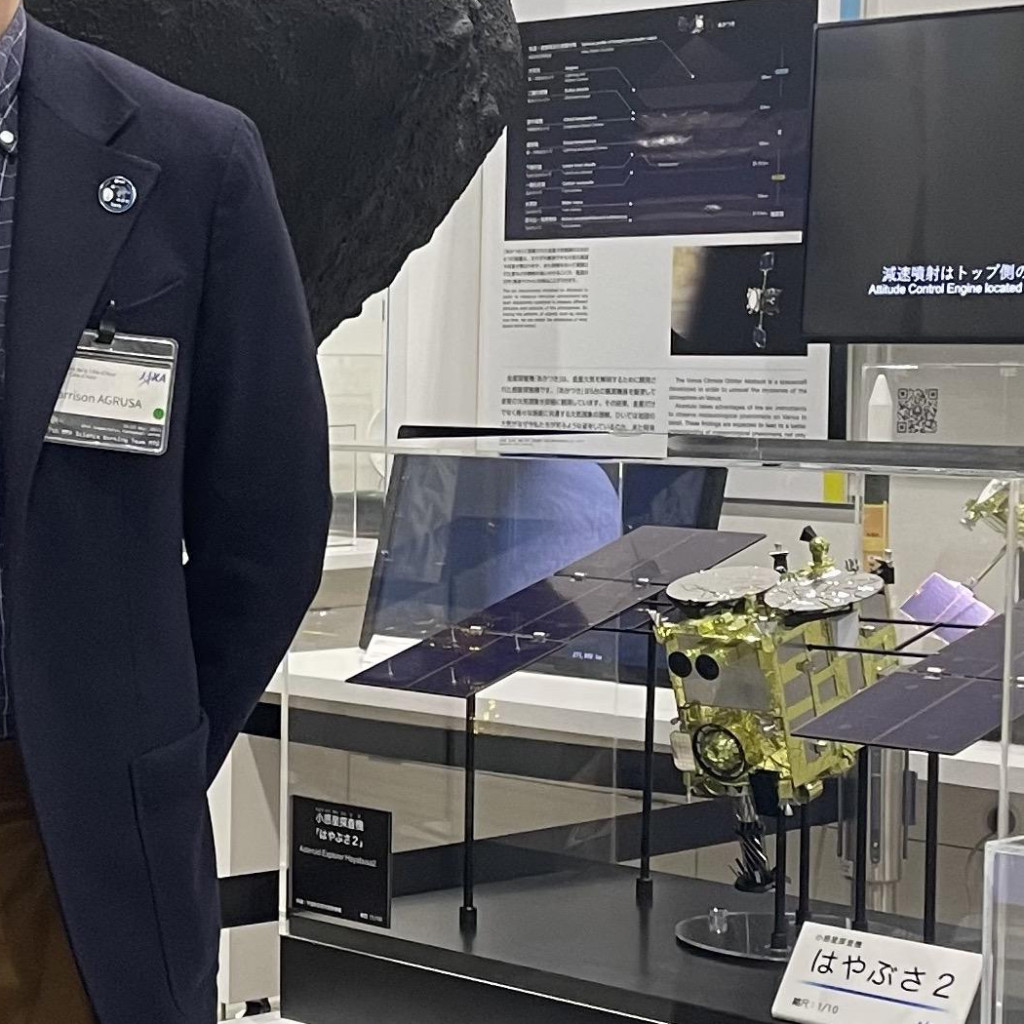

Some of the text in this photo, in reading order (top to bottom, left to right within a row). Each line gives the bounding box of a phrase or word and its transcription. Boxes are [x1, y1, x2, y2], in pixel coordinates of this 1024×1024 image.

[908, 283, 944, 294] Control
[946, 283, 983, 296] Engine
[984, 282, 1023, 294] located
[58, 392, 143, 409] arrison AGRUSA
[811, 948, 956, 999] はやぶさ2
